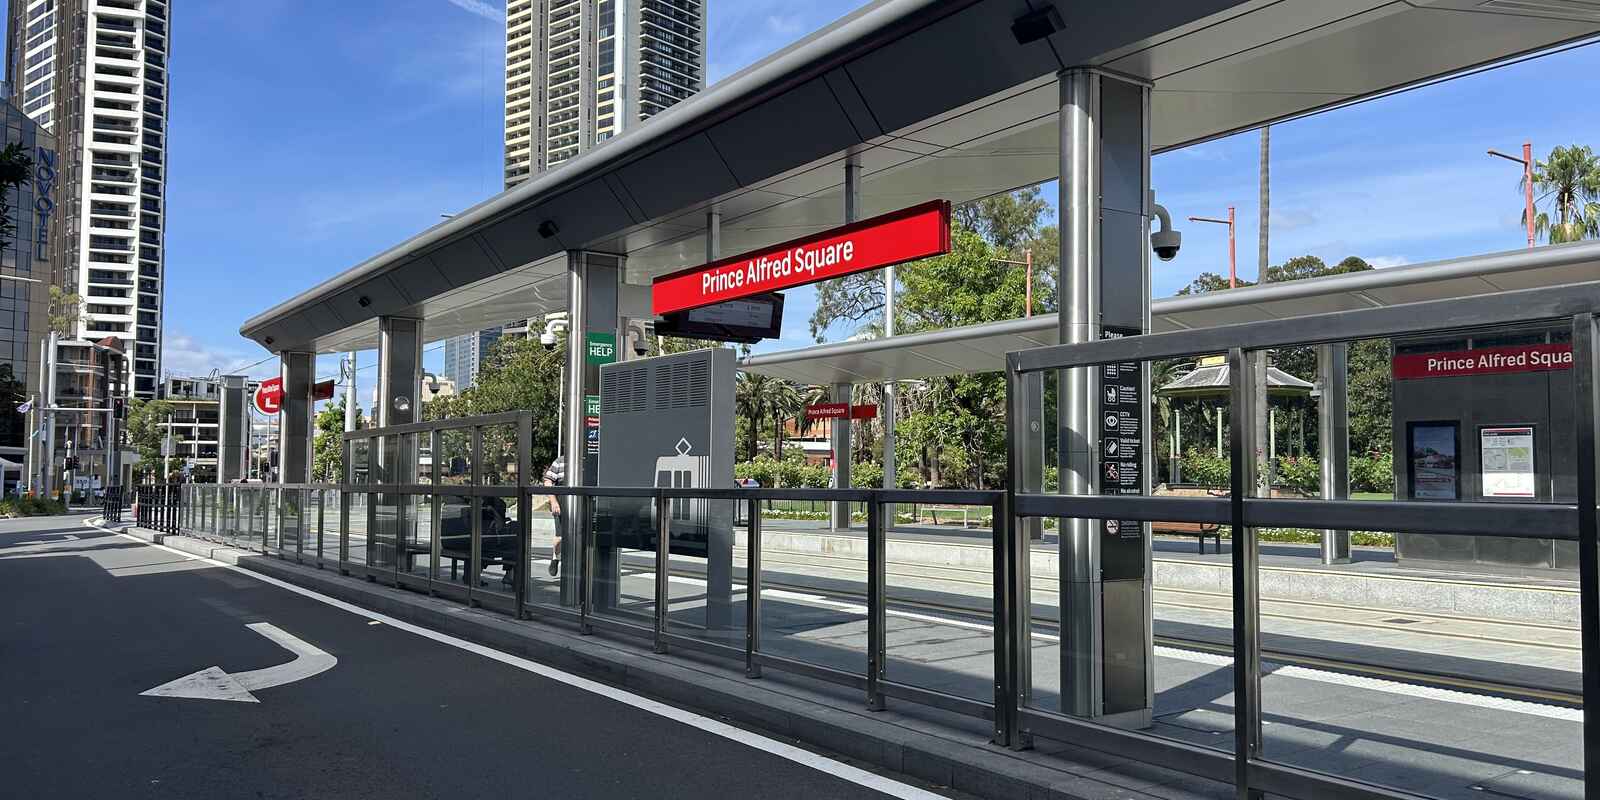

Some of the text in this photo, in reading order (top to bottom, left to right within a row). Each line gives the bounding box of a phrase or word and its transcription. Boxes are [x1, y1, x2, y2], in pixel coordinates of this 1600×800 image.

[36, 146, 54, 262] NOVOTEL
[702, 240, 853, 295] Prince Alfred Square
[590, 346, 613, 357] HELP
[1427, 351, 1573, 371] Prince Alfred Squa
[588, 404, 600, 414] HE
